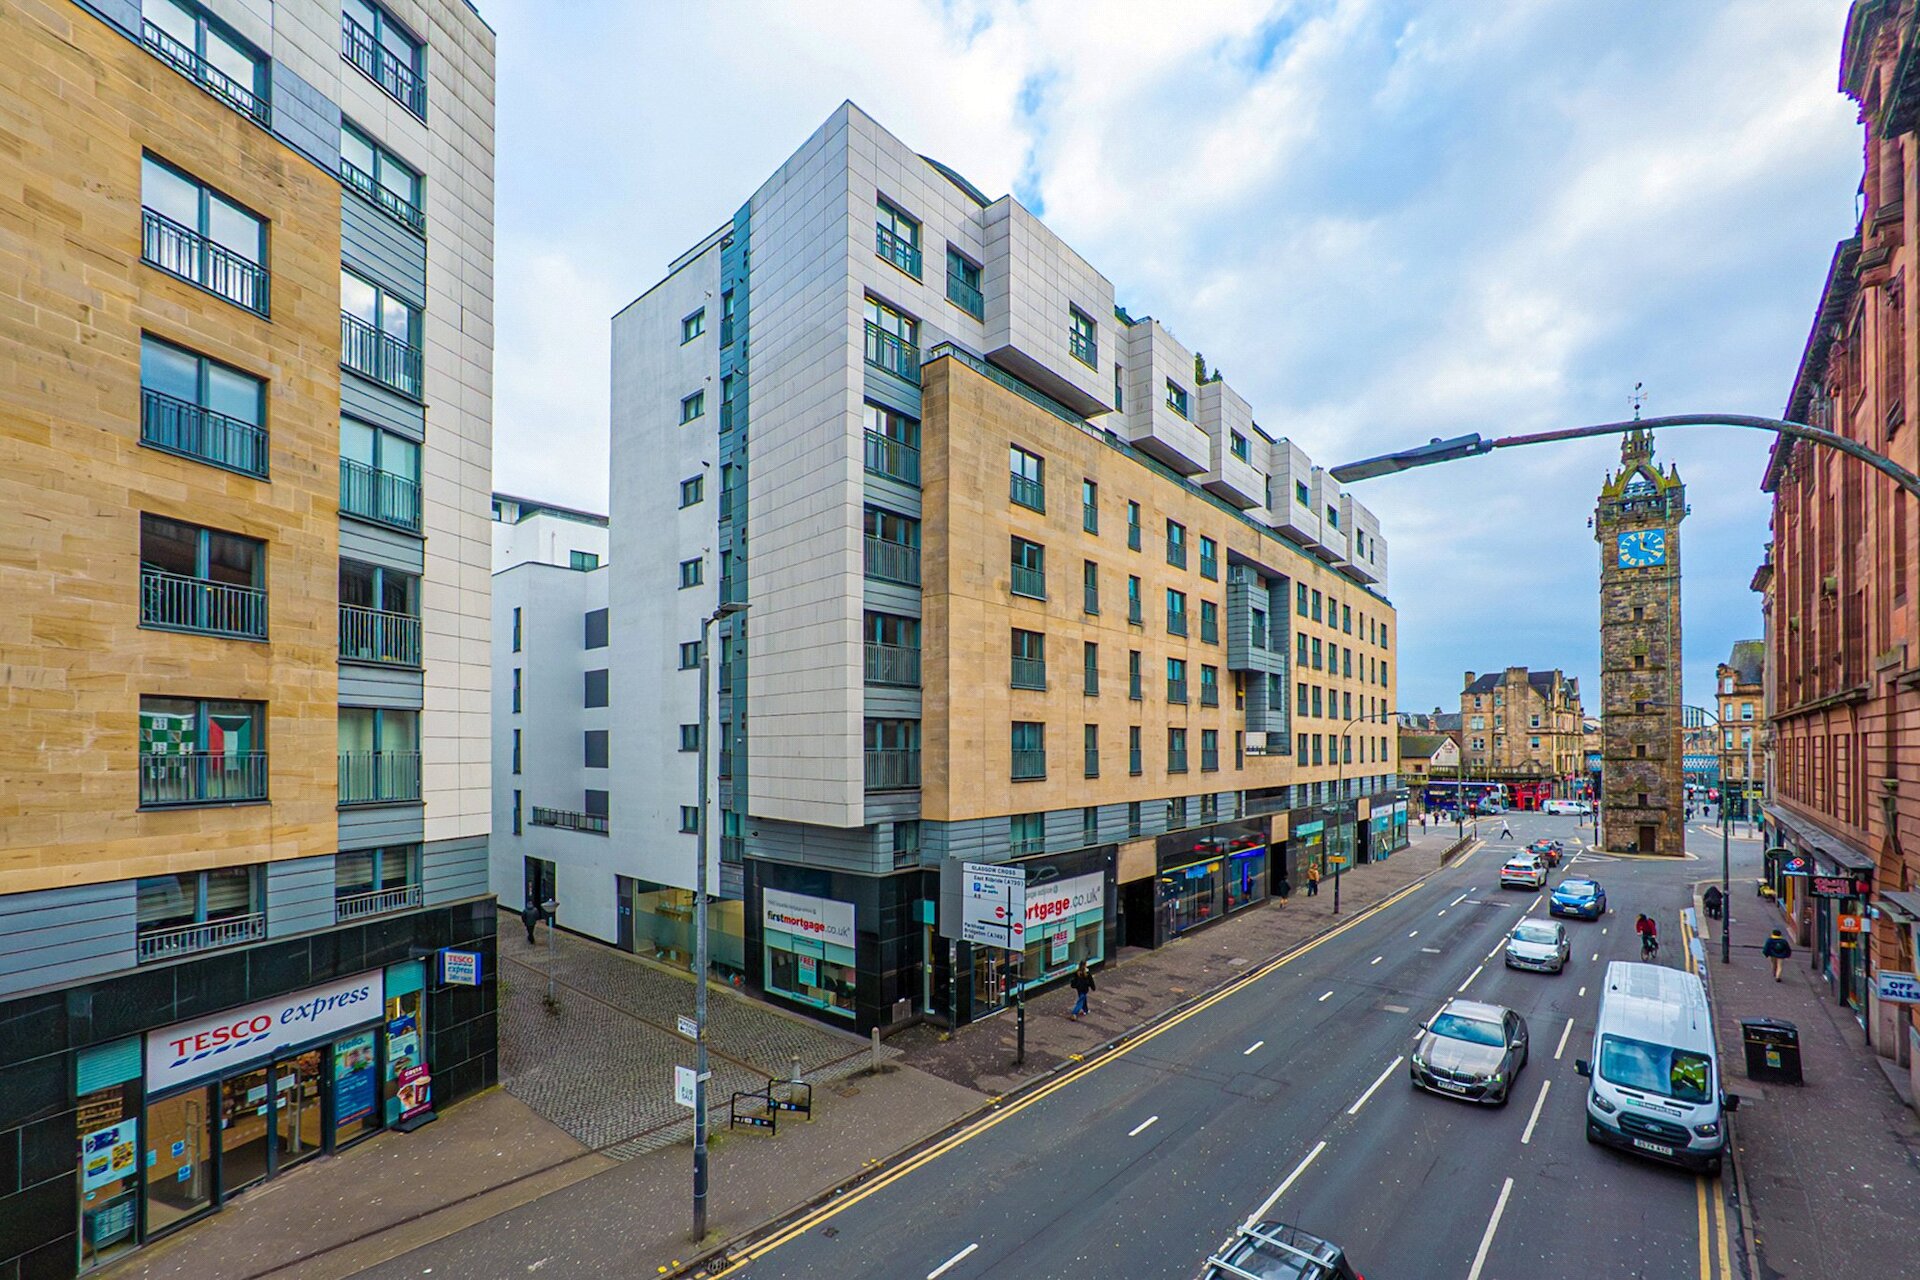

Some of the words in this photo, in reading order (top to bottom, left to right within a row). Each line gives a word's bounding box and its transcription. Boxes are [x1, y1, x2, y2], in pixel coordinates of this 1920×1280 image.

[971, 865, 996, 873] GLASGOW
[964, 927, 986, 936] Bridgeton
[1053, 930, 1067, 940] FREE
[447, 954, 473, 963] TESCO
[447, 966, 473, 975] express
[1889, 981, 1913, 990] OFF
[1881, 989, 1920, 999] SALES
[169, 1015, 271, 1057] TESCO
[280, 986, 369, 1024] express
[338, 1036, 366, 1051] Hello.
